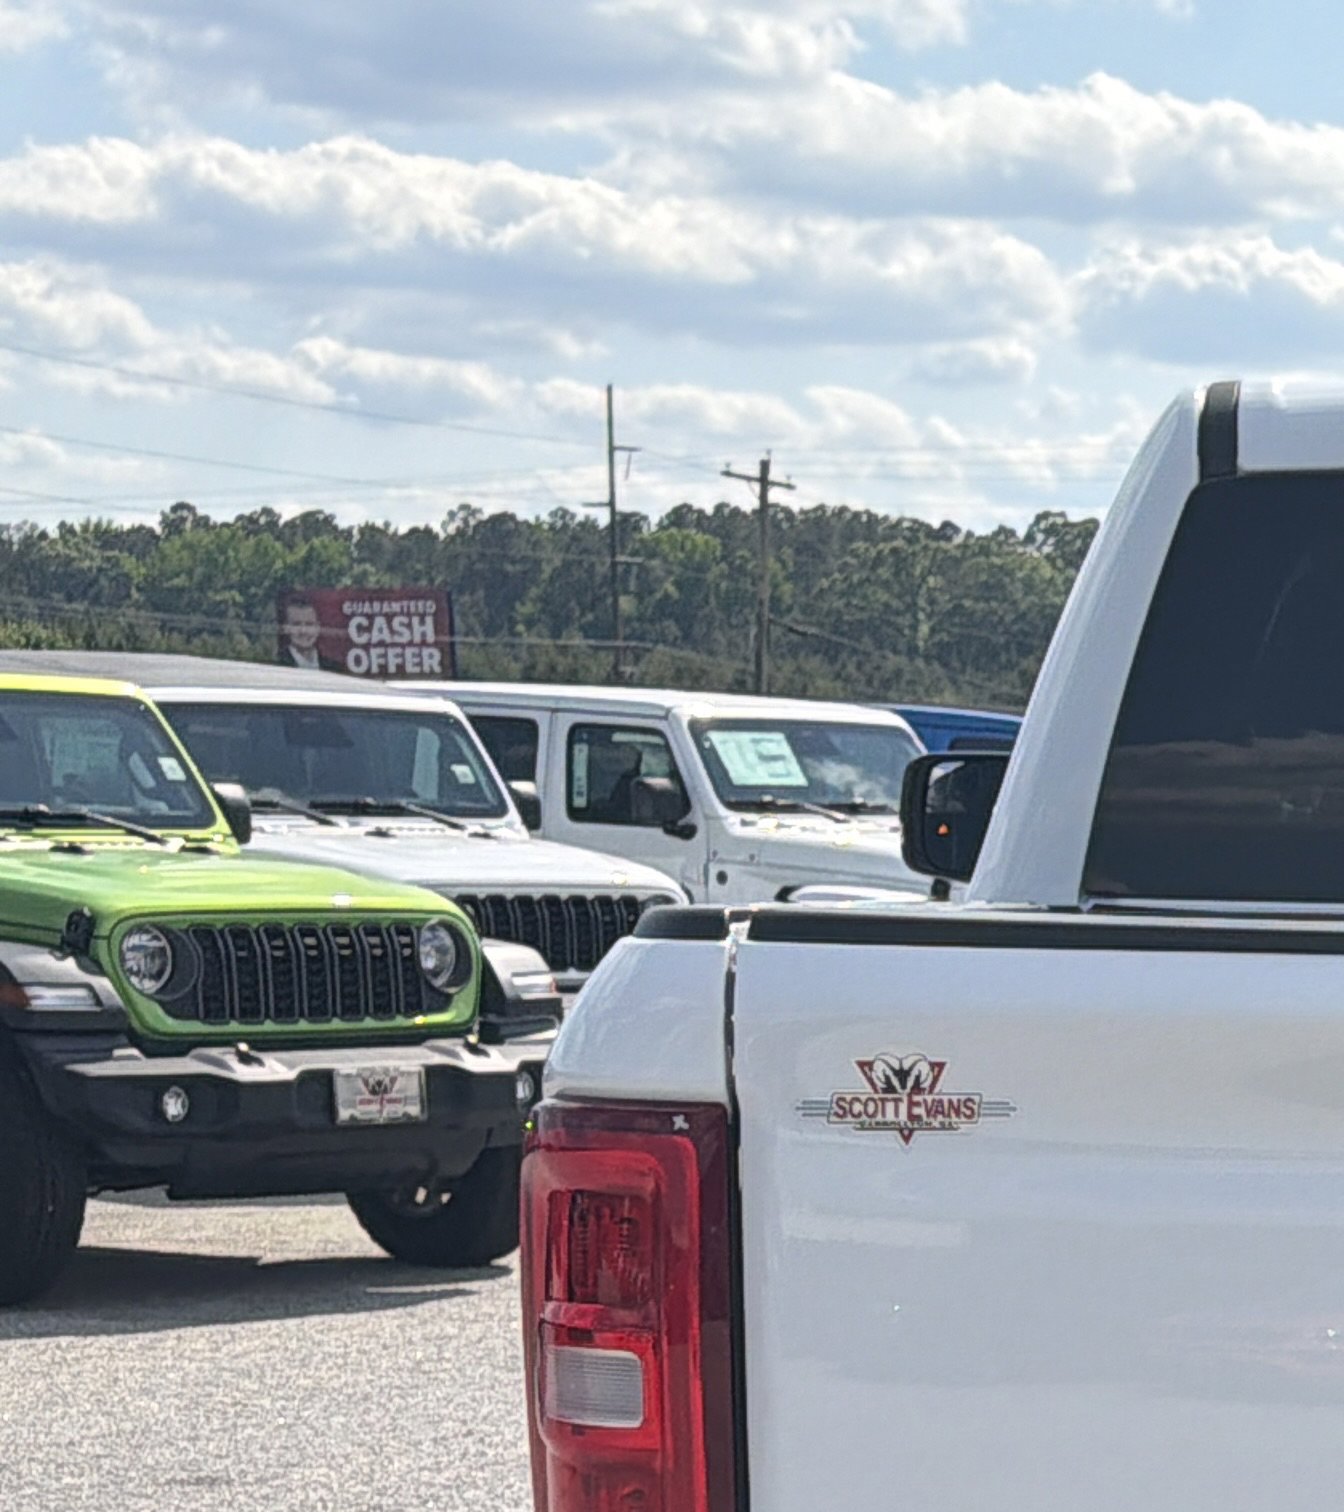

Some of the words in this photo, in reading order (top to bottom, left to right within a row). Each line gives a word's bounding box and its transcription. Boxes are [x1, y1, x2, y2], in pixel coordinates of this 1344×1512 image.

[342, 600, 437, 615] GUARANTEED
[348, 615, 436, 645] CASH
[346, 646, 442, 674] OFFER
[834, 1097, 904, 1119] SCOTT
